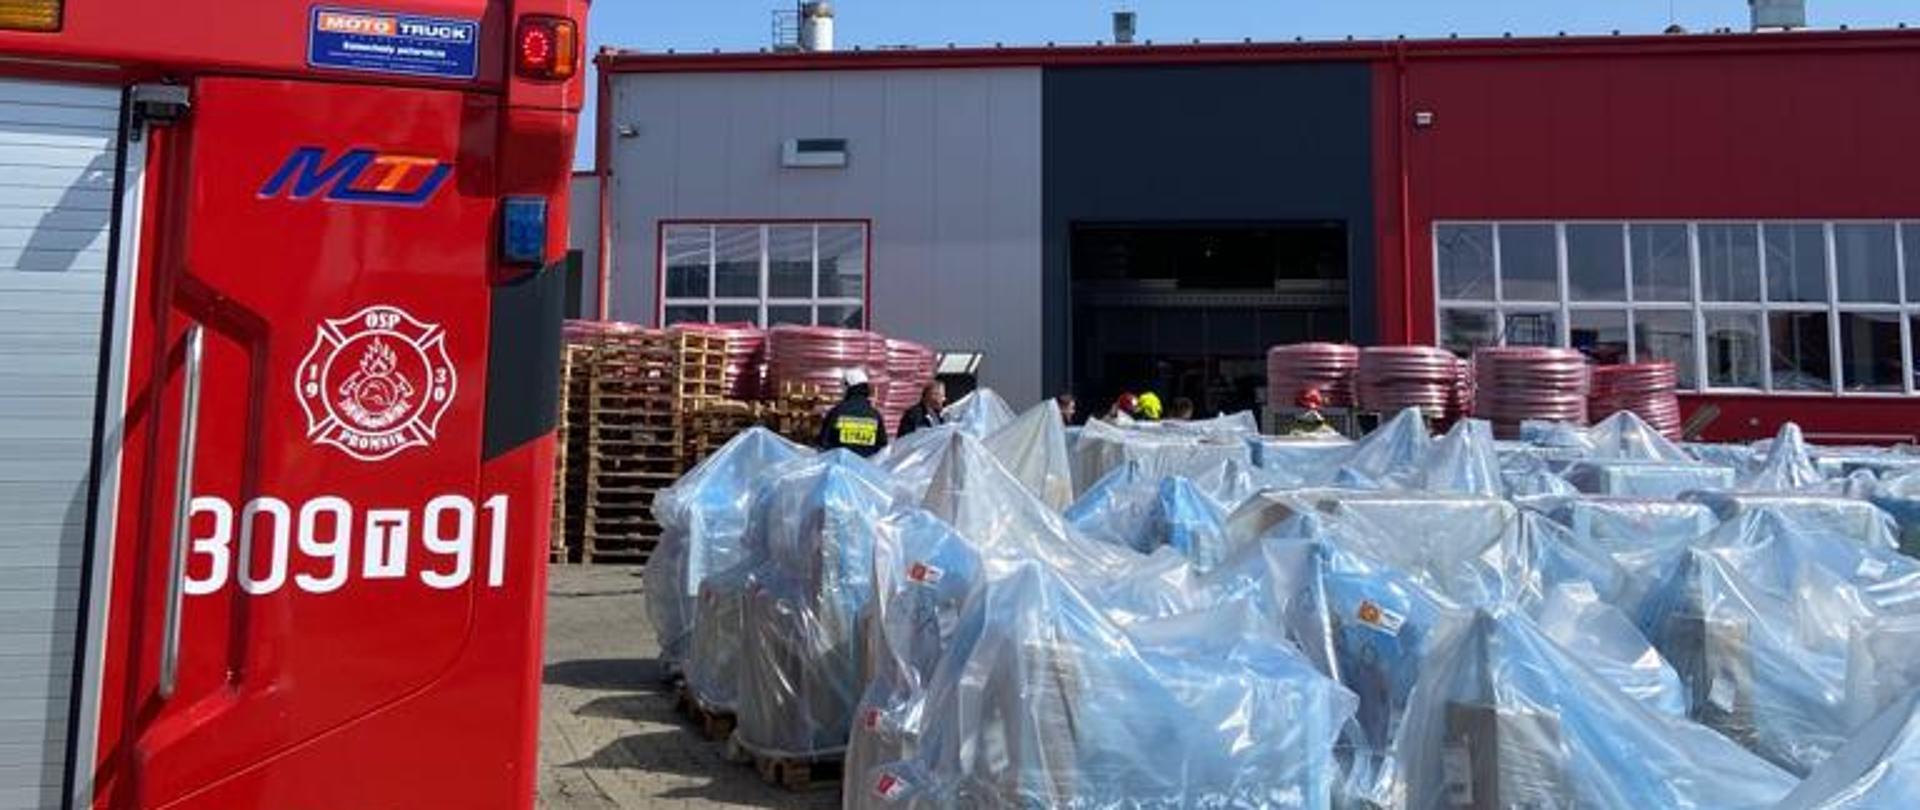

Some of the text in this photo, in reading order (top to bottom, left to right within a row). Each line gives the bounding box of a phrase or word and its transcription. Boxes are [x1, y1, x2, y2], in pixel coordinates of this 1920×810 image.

[325, 16, 467, 39] MOTO TRUCK
[365, 312, 401, 329] OSP
[183, 495, 353, 595] 309
[420, 494, 509, 590] 91
